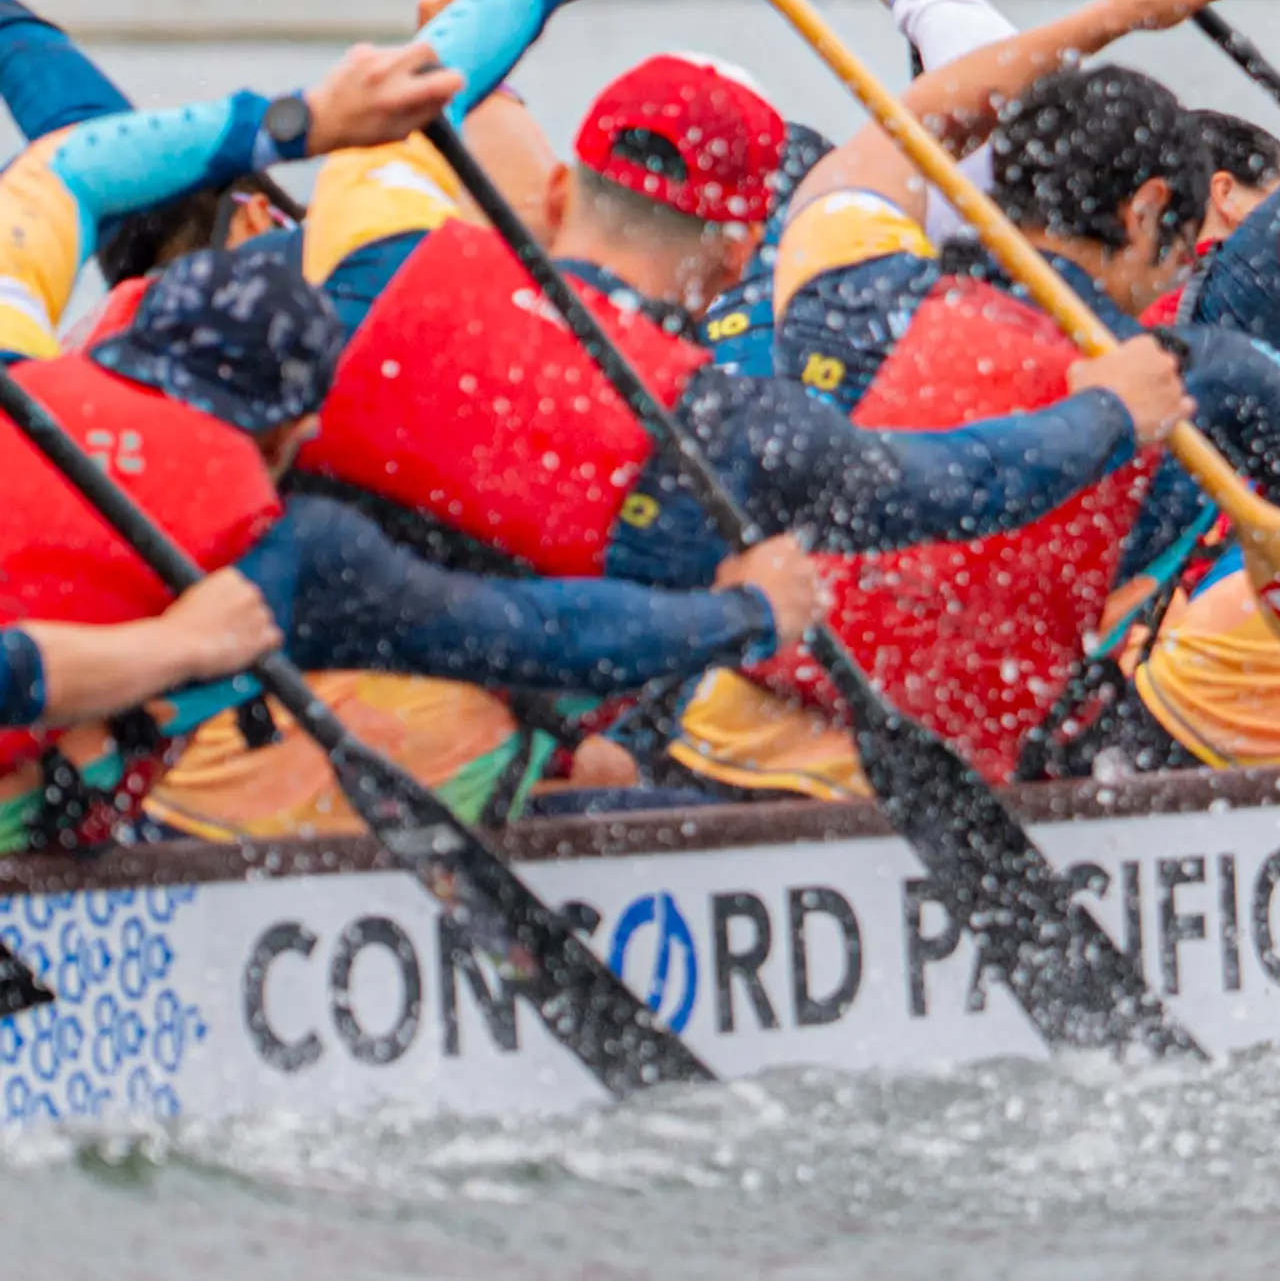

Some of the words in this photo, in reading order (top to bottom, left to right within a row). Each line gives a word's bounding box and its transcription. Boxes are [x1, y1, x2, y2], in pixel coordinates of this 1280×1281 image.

[707, 312, 749, 341] 10
[802, 353, 845, 390] 10
[242, 885, 863, 1074] CONORD
